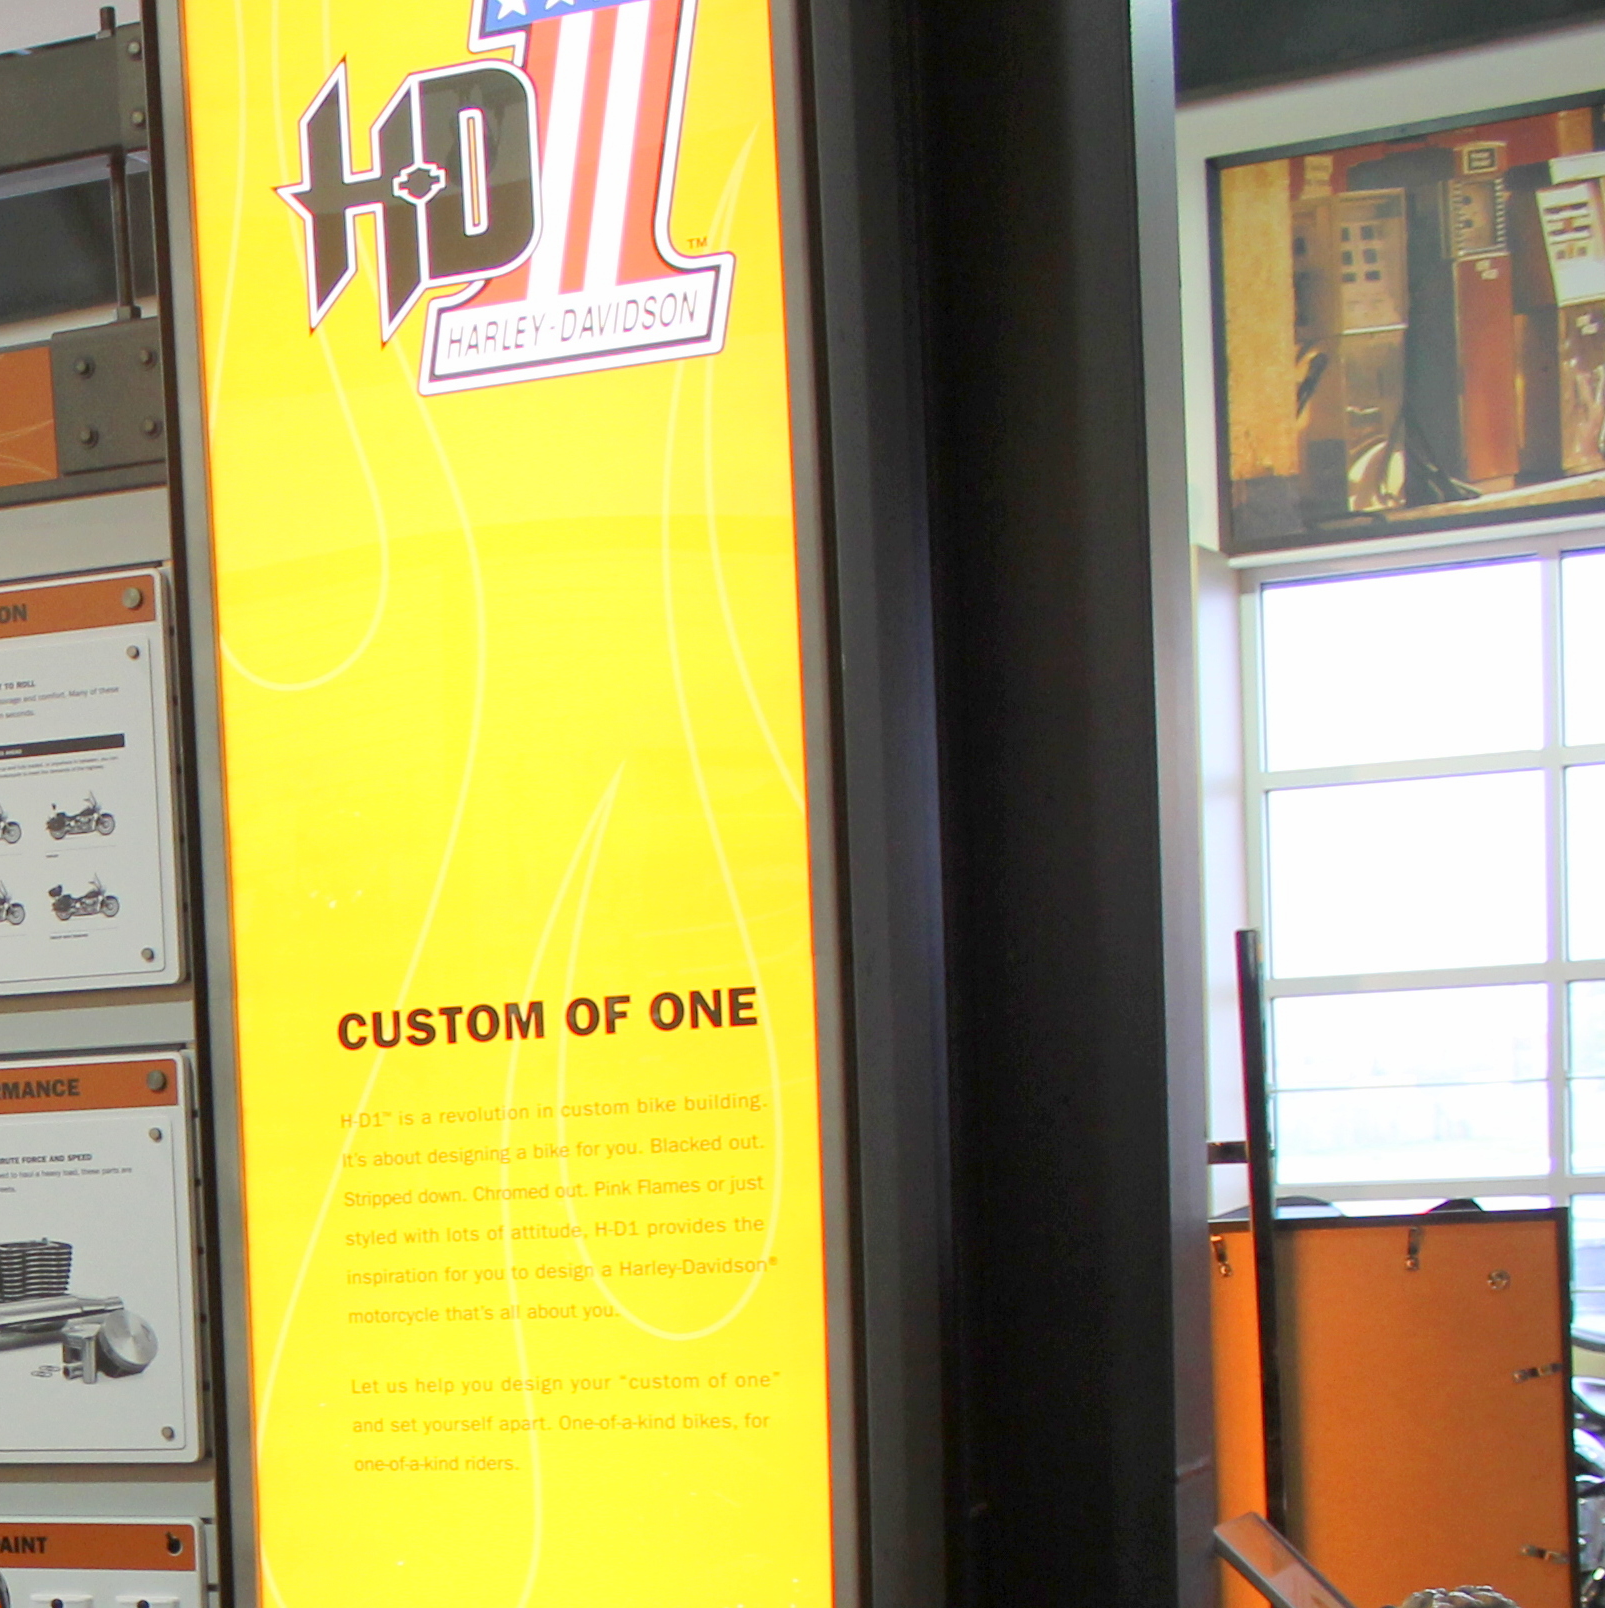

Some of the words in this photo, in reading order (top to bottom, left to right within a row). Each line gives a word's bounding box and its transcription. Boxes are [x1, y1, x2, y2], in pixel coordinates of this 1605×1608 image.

[446, 290, 698, 360] HARLEY-DAVIDSON
[337, 1001, 545, 1051] CUSTOM
[565, 995, 631, 1037] OF
[649, 987, 757, 1032] ONE
[399, 1111, 414, 1126] is
[421, 1112, 431, 1125] a
[439, 1107, 529, 1123] revolution
[537, 1106, 553, 1118] in
[561, 1102, 629, 1118] custom
[637, 1098, 676, 1114] bike
[684, 1094, 766, 1112] building.
[342, 1153, 367, 1167] It's
[373, 1151, 421, 1167] about
[427, 1147, 511, 1166] designing
[516, 1148, 527, 1160] a
[533, 1144, 570, 1159] bike
[576, 1141, 600, 1157] for
[606, 1143, 642, 1159] you.
[650, 1135, 722, 1154] Blacked
[728, 1135, 763, 1150] out.
[344, 1190, 412, 1208] Stripped
[418, 1189, 466, 1204] down.
[473, 1184, 549, 1202] Chromed
[555, 1184, 587, 1198] out.
[594, 1181, 631, 1196] Pink
[637, 1179, 701, 1195] Flames
[707, 1179, 724, 1192] or
[729, 1176, 763, 1195] just
[345, 1230, 397, 1249] styled
[403, 1228, 439, 1243] with
[447, 1228, 479, 1242] lots
[487, 1225, 504, 1241] of
[511, 1223, 587, 1240] attitude,
[595, 1220, 638, 1237] H-D1
[647, 1218, 727, 1238] provides
[734, 1216, 764, 1232] the
[347, 1268, 437, 1287] inspiration
[444, 1267, 467, 1282] for
[474, 1269, 504, 1284] you
[511, 1266, 529, 1280] to
[535, 1264, 594, 1282] design
[601, 1265, 612, 1277] a
[348, 1308, 439, 1325] motorcycle
[445, 1306, 494, 1321] that's
[500, 1305, 520, 1320] all
[527, 1304, 577, 1319] about
[583, 1305, 618, 1321] you.
[351, 1380, 379, 1394] Let
[387, 1381, 408, 1393] us
[415, 1379, 454, 1395] help
[462, 1380, 493, 1395] you
[501, 1377, 563, 1395] design
[571, 1378, 610, 1393] your
[708, 1372, 727, 1388] of
[353, 1418, 384, 1433] and
[391, 1419, 417, 1433] set
[423, 1416, 492, 1435] yourself
[499, 1417, 551, 1433] apart.
[559, 1414, 675, 1431] One-of-a-kind
[682, 1414, 737, 1430] bikes,
[744, 1413, 769, 1428] for
[354, 1456, 459, 1472] one-of-a-kind
[465, 1457, 519, 1471] riders.
